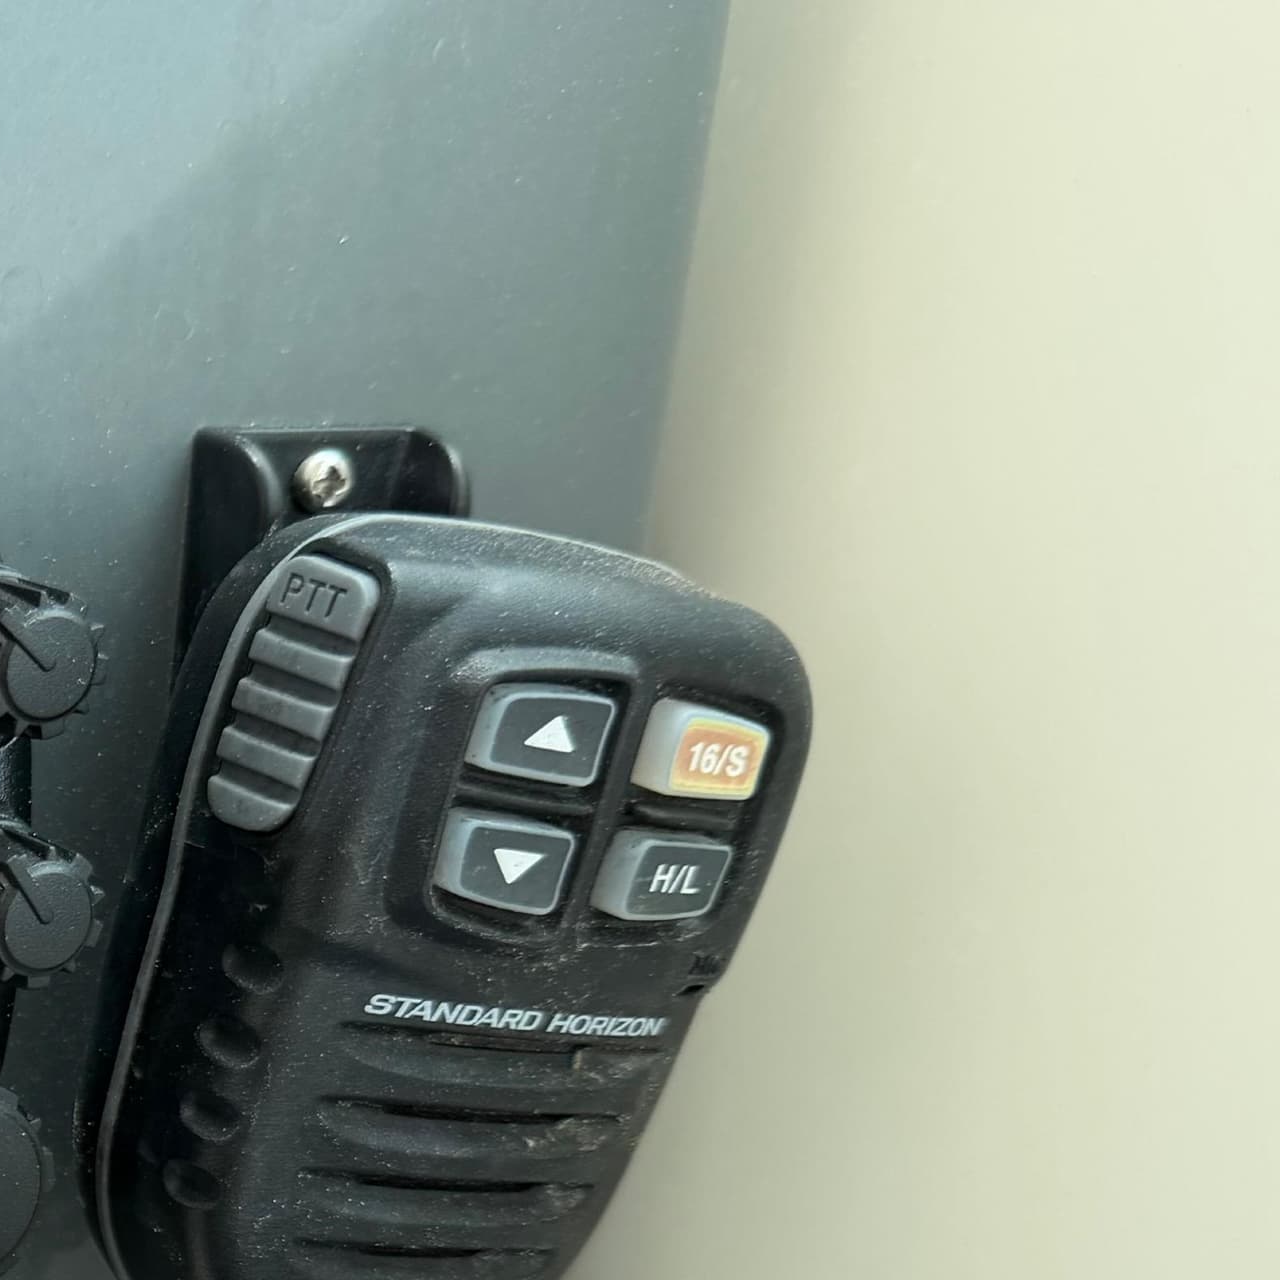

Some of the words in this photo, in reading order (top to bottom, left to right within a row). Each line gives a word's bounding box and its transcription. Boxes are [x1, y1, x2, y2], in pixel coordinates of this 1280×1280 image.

[281, 572, 348, 618] PTT
[688, 740, 749, 777] 16/S
[649, 863, 703, 895] H/L
[363, 994, 544, 1032] STANDARD
[546, 1014, 665, 1038] HORIZON
